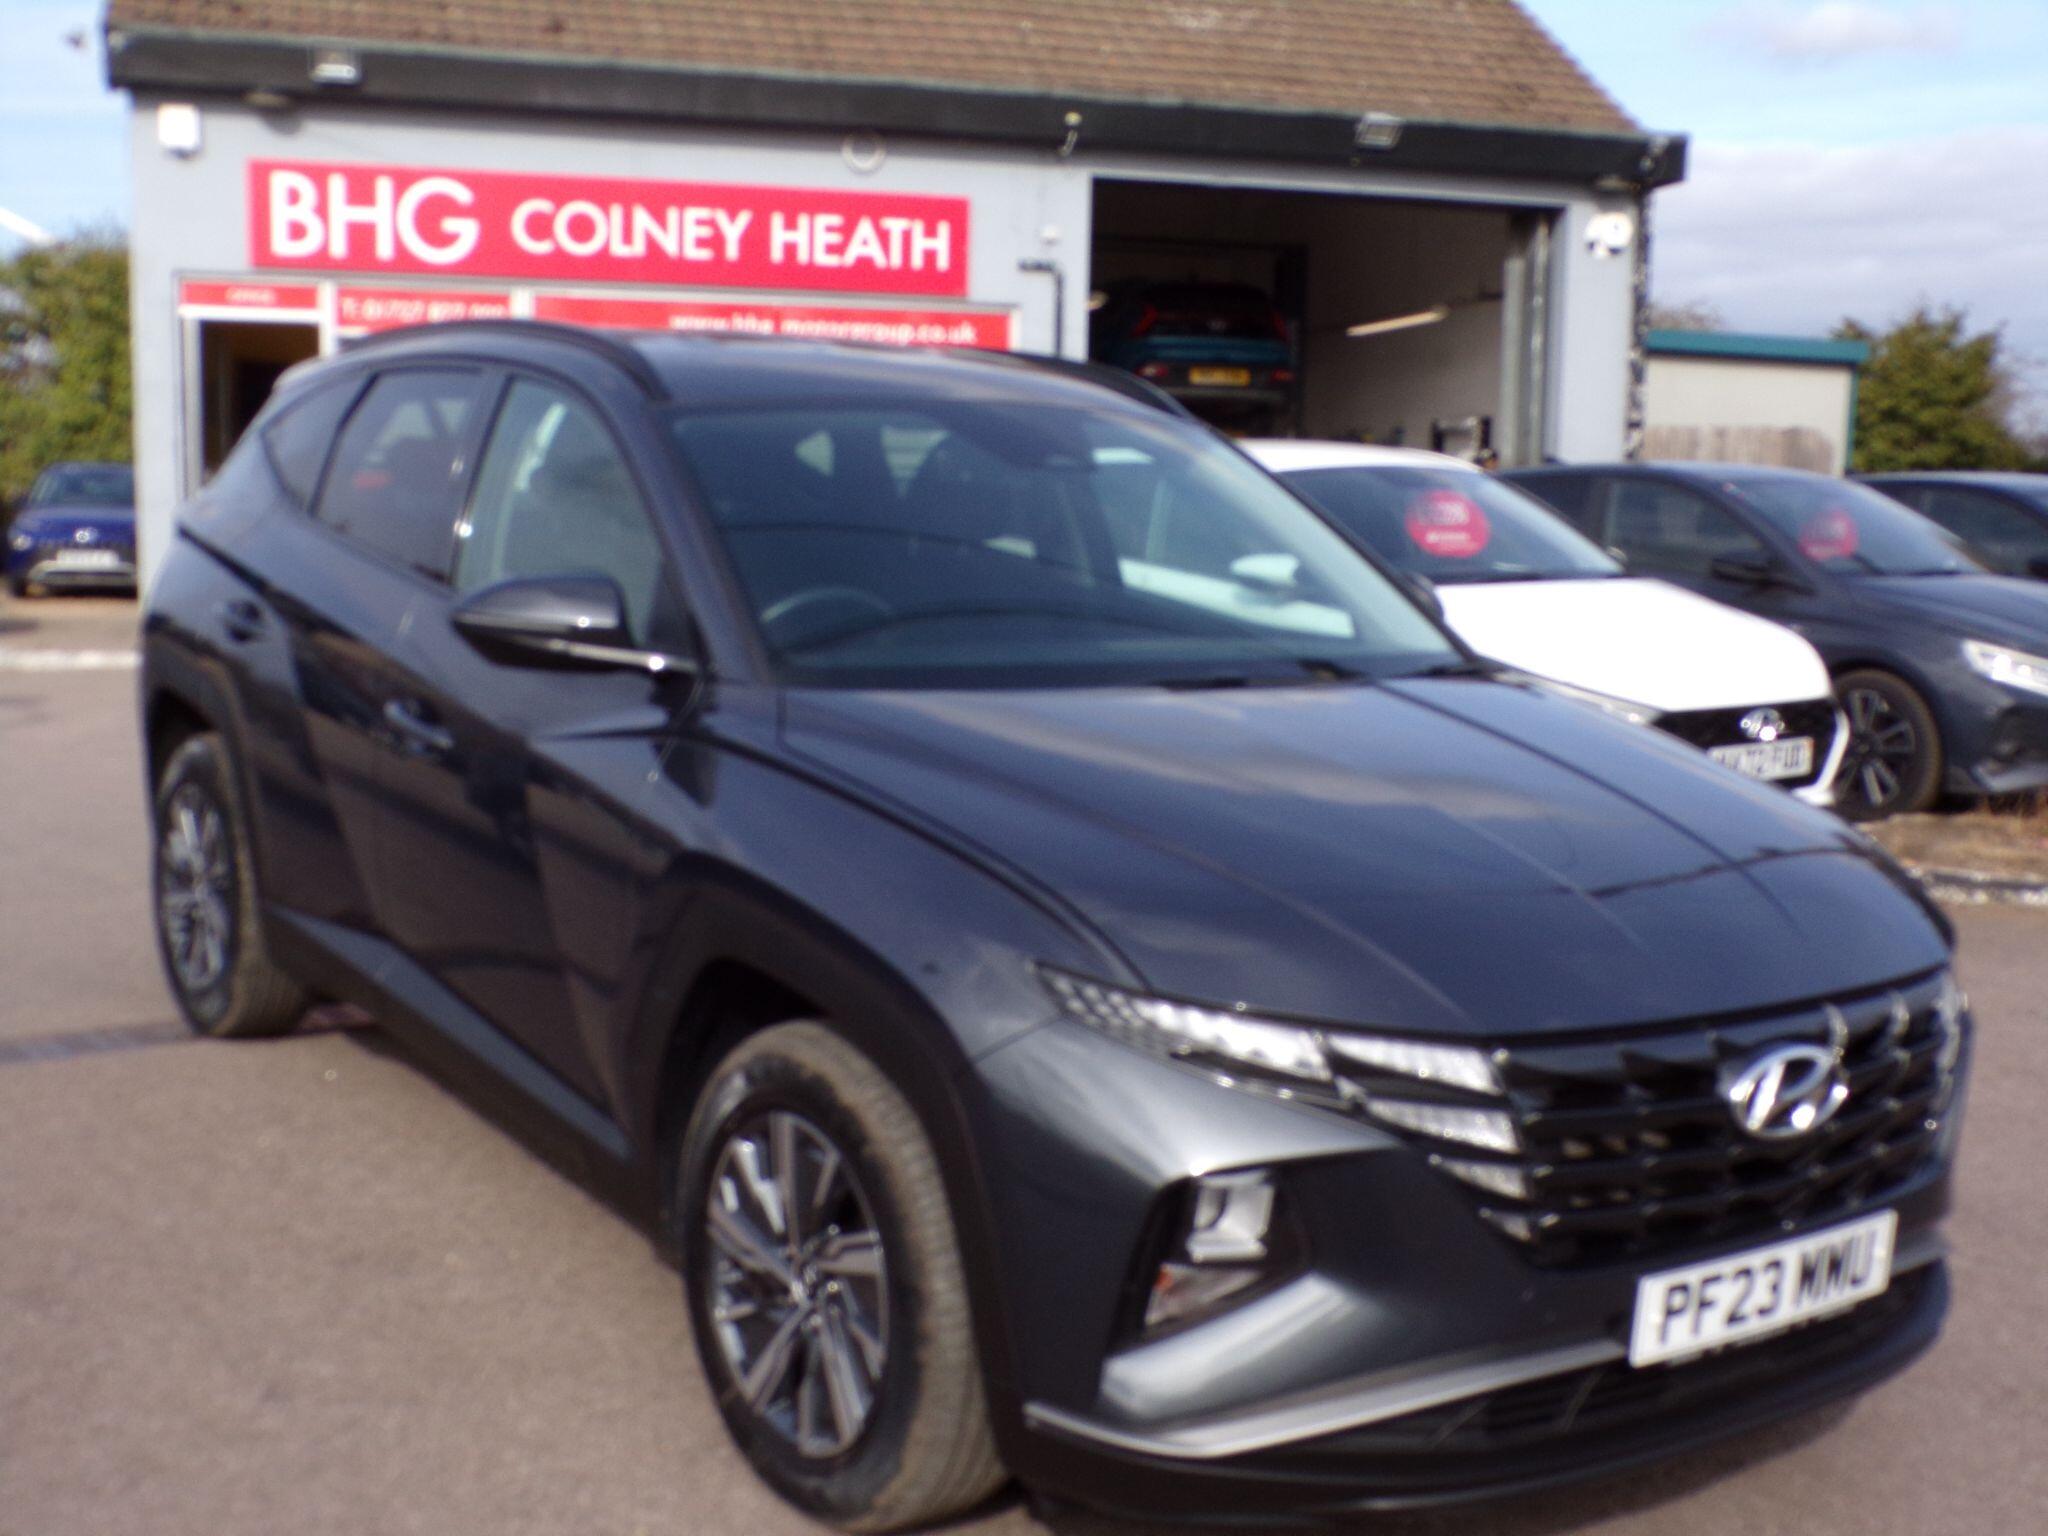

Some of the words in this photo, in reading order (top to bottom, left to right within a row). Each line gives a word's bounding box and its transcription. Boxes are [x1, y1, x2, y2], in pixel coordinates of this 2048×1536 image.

[270, 170, 481, 265] BHG
[510, 199, 752, 262] COLNEY
[770, 212, 950, 271] HEATH
[1658, 1259, 1783, 1344] PF23
